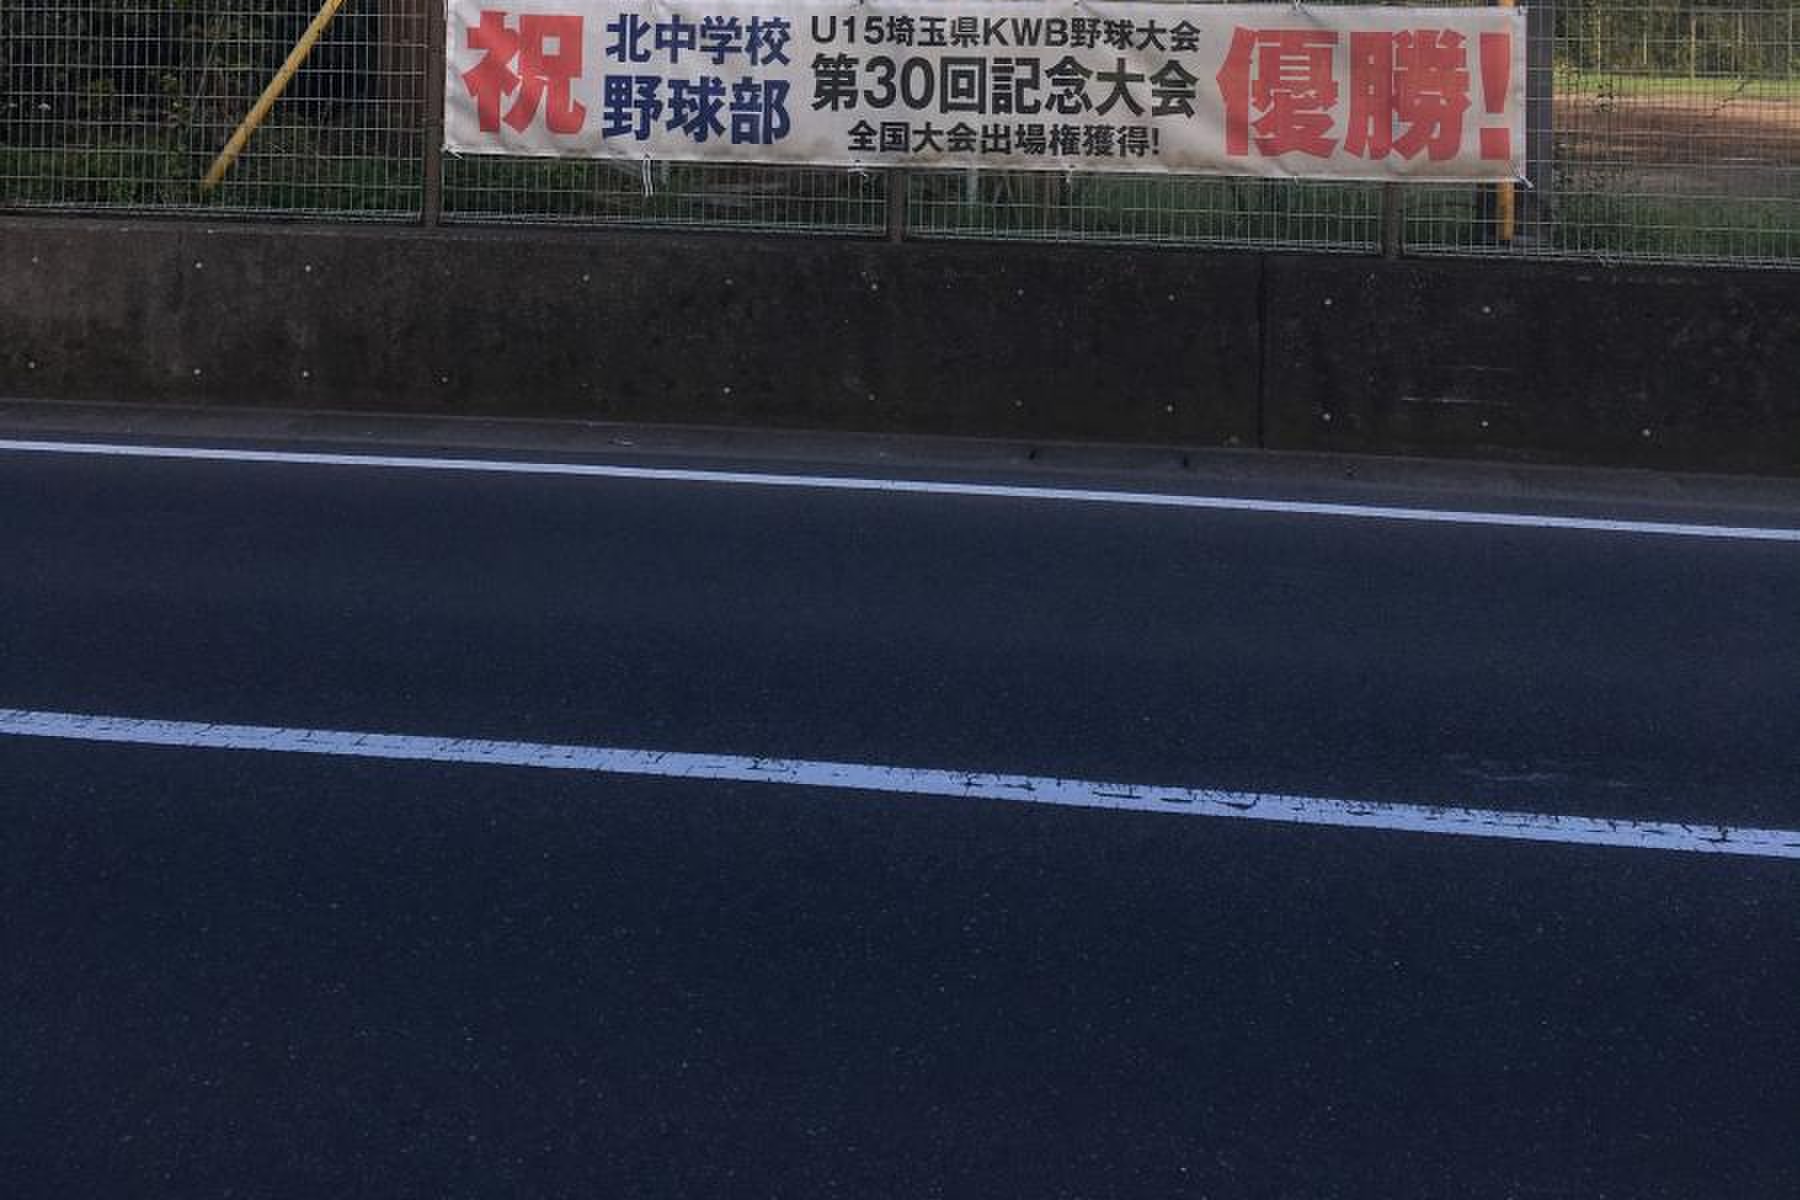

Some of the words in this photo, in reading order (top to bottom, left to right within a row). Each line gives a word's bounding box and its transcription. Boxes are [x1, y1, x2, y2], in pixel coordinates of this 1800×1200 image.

[606, 14, 791, 66] 北中学校
[810, 15, 1200, 53] U15埼玉県KWB野球大会
[463, 11, 586, 136] 祝
[810, 53, 1200, 118] 第30回記念大会
[1216, 26, 1511, 162] 優勝!
[602, 75, 791, 145] 野球部
[848, 120, 1160, 159] 全国大会出場権獲得!
